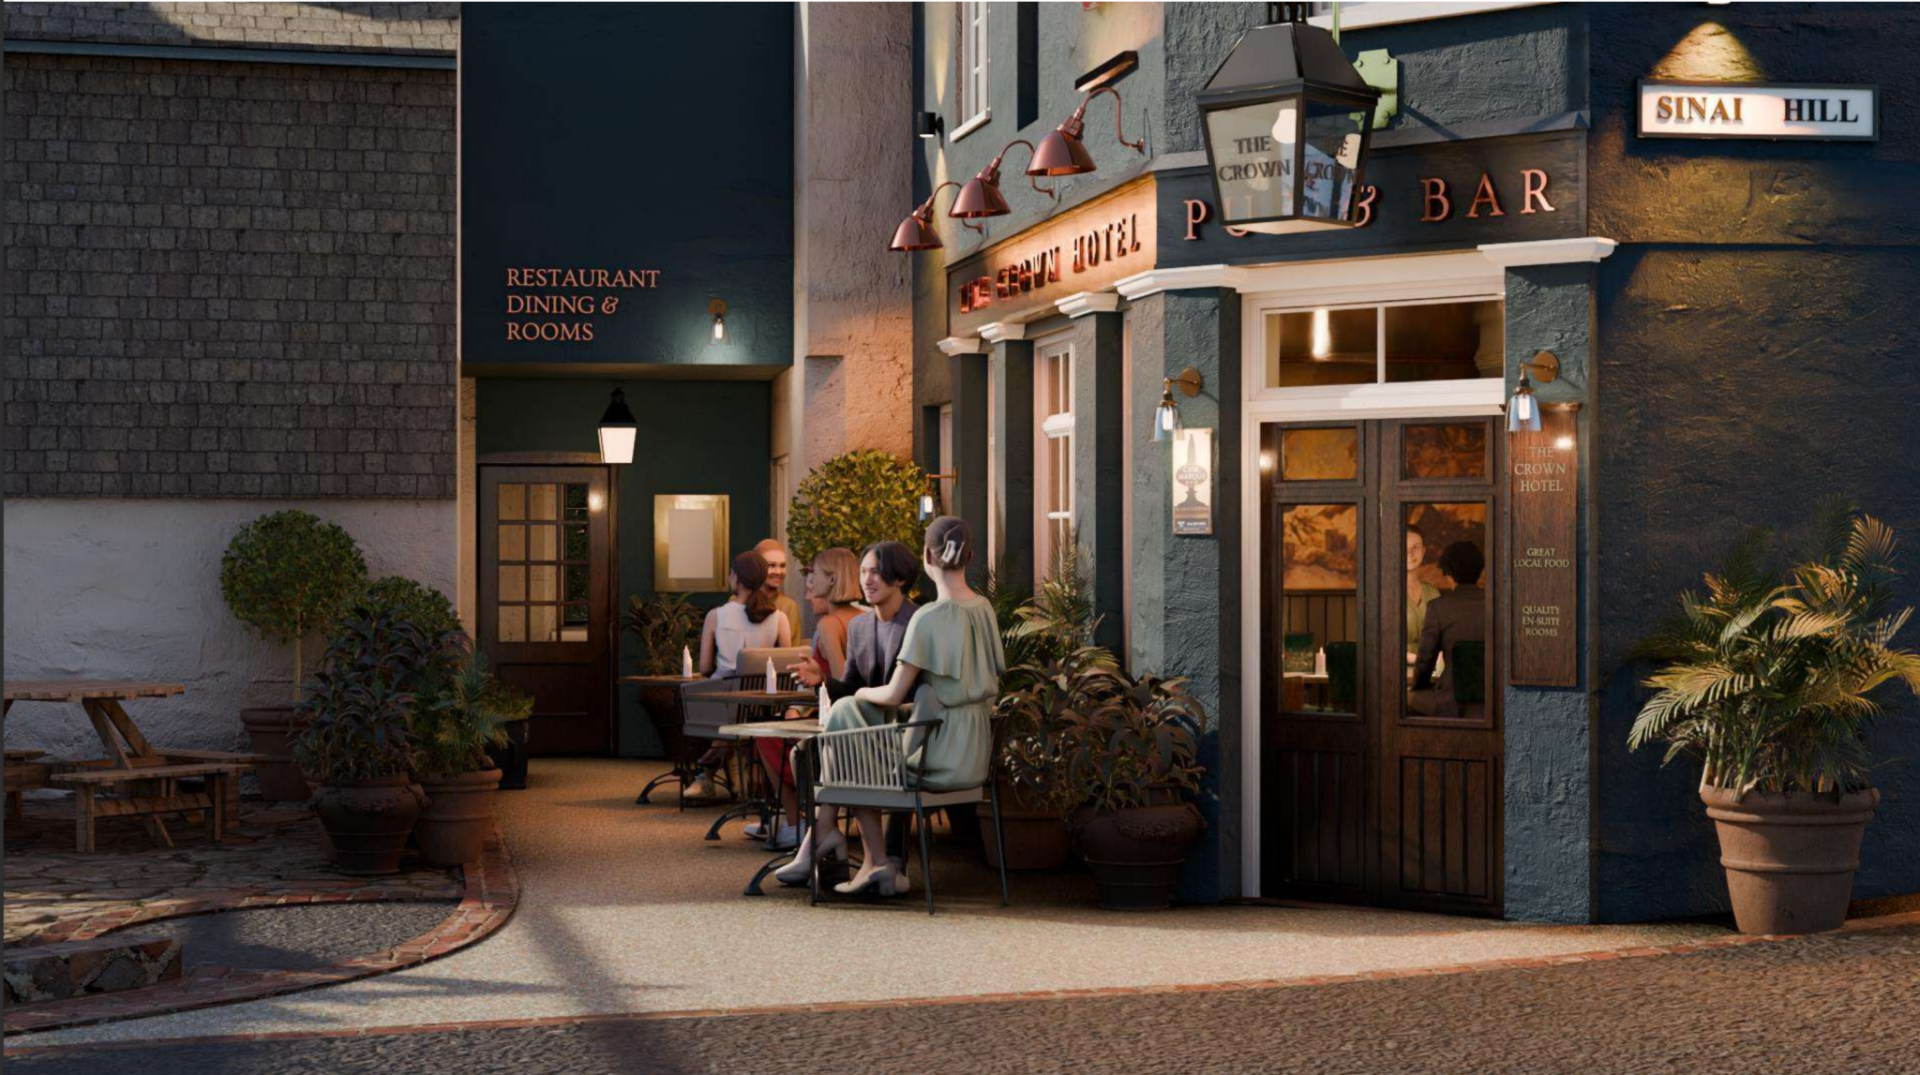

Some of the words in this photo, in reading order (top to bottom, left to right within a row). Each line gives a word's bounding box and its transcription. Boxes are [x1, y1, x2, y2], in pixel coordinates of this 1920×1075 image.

[1656, 95, 1743, 123] SINAI
[1783, 98, 1859, 123] HILL
[1234, 136, 1270, 155] THE
[1219, 159, 1290, 182] CROWN
[1420, 168, 1556, 223] BAR
[996, 246, 1061, 299] CROWN
[1073, 213, 1142, 274] HOTEL
[507, 268, 661, 288] RESTAURANT
[506, 295, 595, 314] DINING
[601, 296, 619, 315] &
[506, 322, 594, 341] ROOMS
[1529, 446, 1555, 458] THE
[1514, 463, 1566, 475] CROWN
[1520, 480, 1564, 492] HOTEL
[1526, 548, 1555, 557] GREAT
[1513, 559, 1542, 568] LOCAL
[1544, 559, 1570, 568] FOOD
[1522, 605, 1560, 615] QUALITY
[1525, 628, 1558, 637] ROOMS
